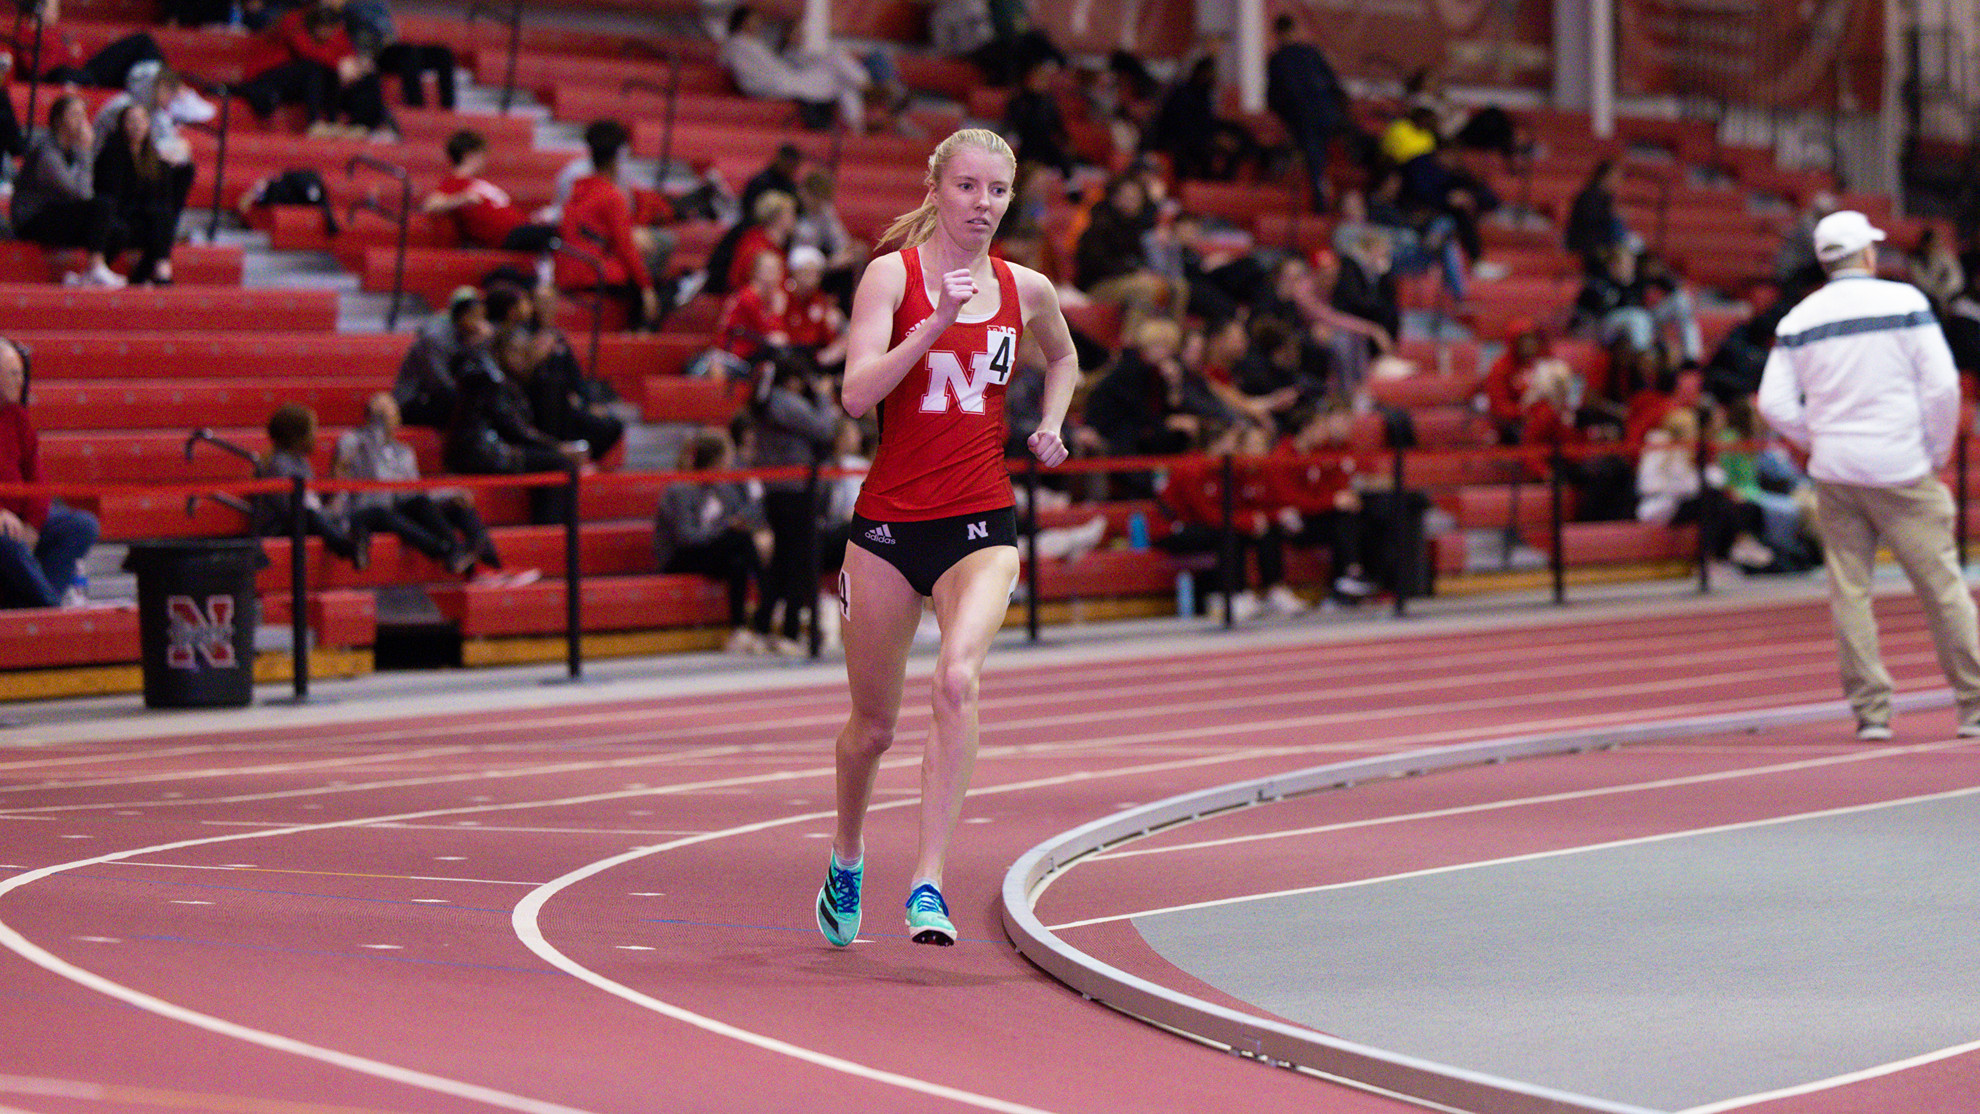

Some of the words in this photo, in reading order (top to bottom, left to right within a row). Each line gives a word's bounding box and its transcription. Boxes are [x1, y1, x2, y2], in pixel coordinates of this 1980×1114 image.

[989, 336, 1010, 381] 4
[919, 350, 989, 415] N
[864, 531, 897, 545] adidas
[967, 521, 989, 540] N
[840, 571, 848, 615] 4
[168, 594, 237, 669] N
